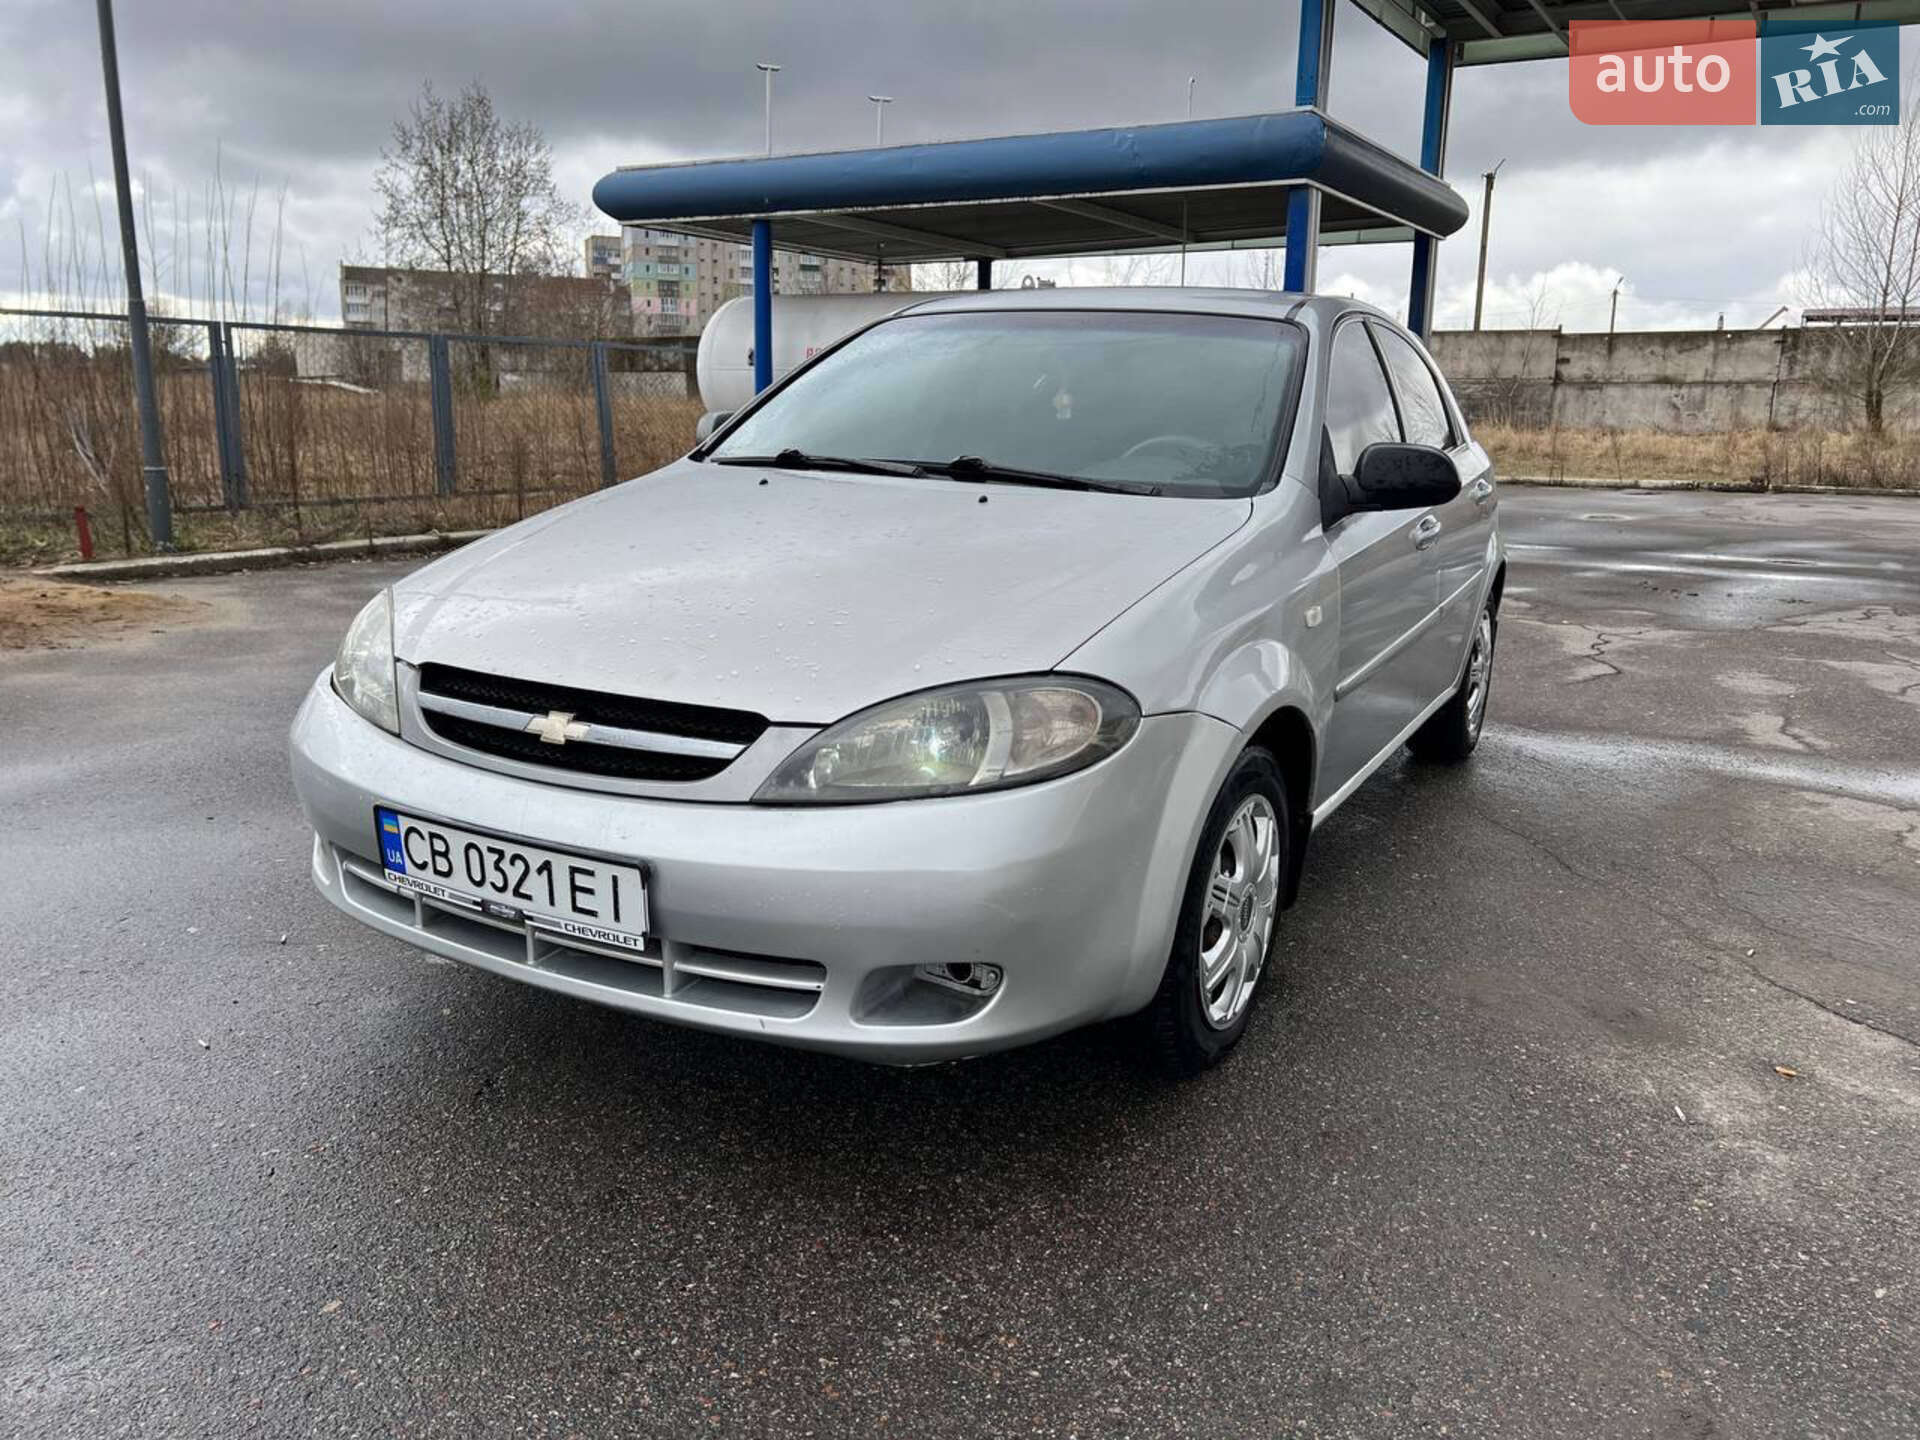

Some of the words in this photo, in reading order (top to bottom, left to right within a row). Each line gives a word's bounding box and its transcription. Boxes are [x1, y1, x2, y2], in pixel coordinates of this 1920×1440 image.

[386, 847, 402, 865] UA
[388, 872, 446, 897] CHEVROLET
[403, 825, 454, 878] CB
[464, 842, 555, 907] 0321
[569, 865, 620, 923] EI
[564, 922, 641, 947] CHEVROLET
